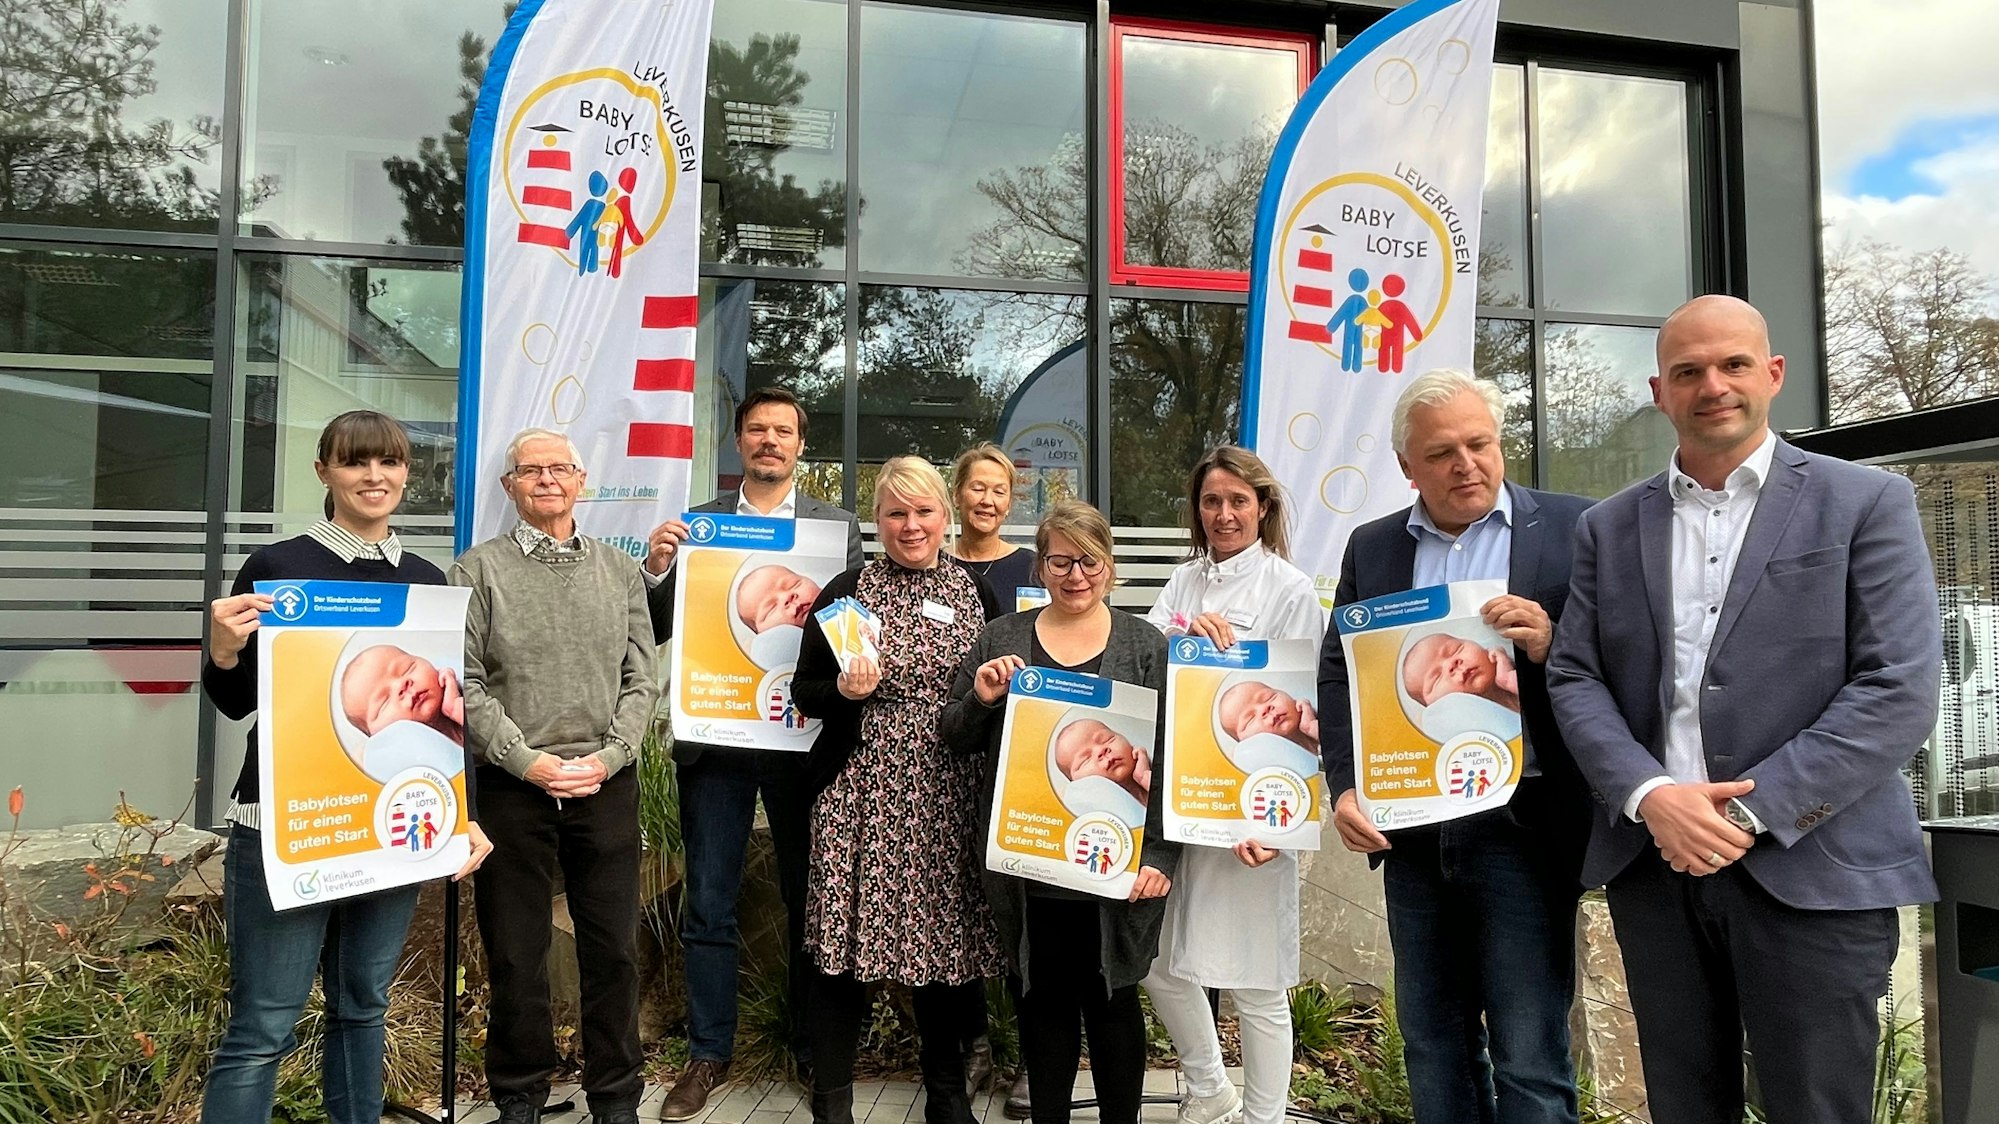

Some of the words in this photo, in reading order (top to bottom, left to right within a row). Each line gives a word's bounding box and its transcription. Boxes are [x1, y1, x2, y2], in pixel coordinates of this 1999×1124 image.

[579, 100, 634, 131] BABY
[634, 61, 696, 173] LEVERKUSEN
[1341, 204, 1395, 229] BABY
[1394, 161, 1471, 274] LEVERKUSEN
[1366, 235, 1428, 258] LOTSE
[599, 486, 616, 498] Start
[617, 486, 630, 497] ins
[632, 485, 659, 498] Leben
[690, 671, 752, 684] Babylotsen
[690, 685, 705, 695] für
[709, 687, 738, 697] einen
[690, 701, 722, 711] guten
[724, 700, 752, 711] Start
[1369, 750, 1429, 764] Babylotsen
[1463, 751, 1481, 759] BABY
[1479, 735, 1508, 765] LEVERKUSEN
[1472, 757, 1493, 766] LOTSE
[1370, 766, 1383, 777] für
[1386, 765, 1417, 775] einen
[1180, 775, 1236, 787] Babylotsen
[1370, 780, 1401, 792] guten
[1403, 777, 1432, 788] Start
[405, 790, 426, 800] BABY
[423, 772, 452, 807] LEVERKUSEN
[1180, 788, 1194, 797] für
[1196, 789, 1224, 799] einen
[287, 793, 368, 814] Babylotsen
[415, 798, 438, 808] LOTSE
[1180, 800, 1209, 810] guten
[1211, 801, 1236, 811] Start
[287, 818, 307, 832] für
[312, 812, 352, 828] einen
[1008, 809, 1064, 826] Babylotsen
[1006, 821, 1021, 831] für
[1022, 825, 1050, 837] einen
[288, 835, 331, 854] guten
[334, 827, 369, 844] Start
[1004, 834, 1034, 847] guten
[1035, 839, 1061, 852] Start
[322, 869, 364, 883] klinikum
[325, 876, 375, 892] leverkusen
